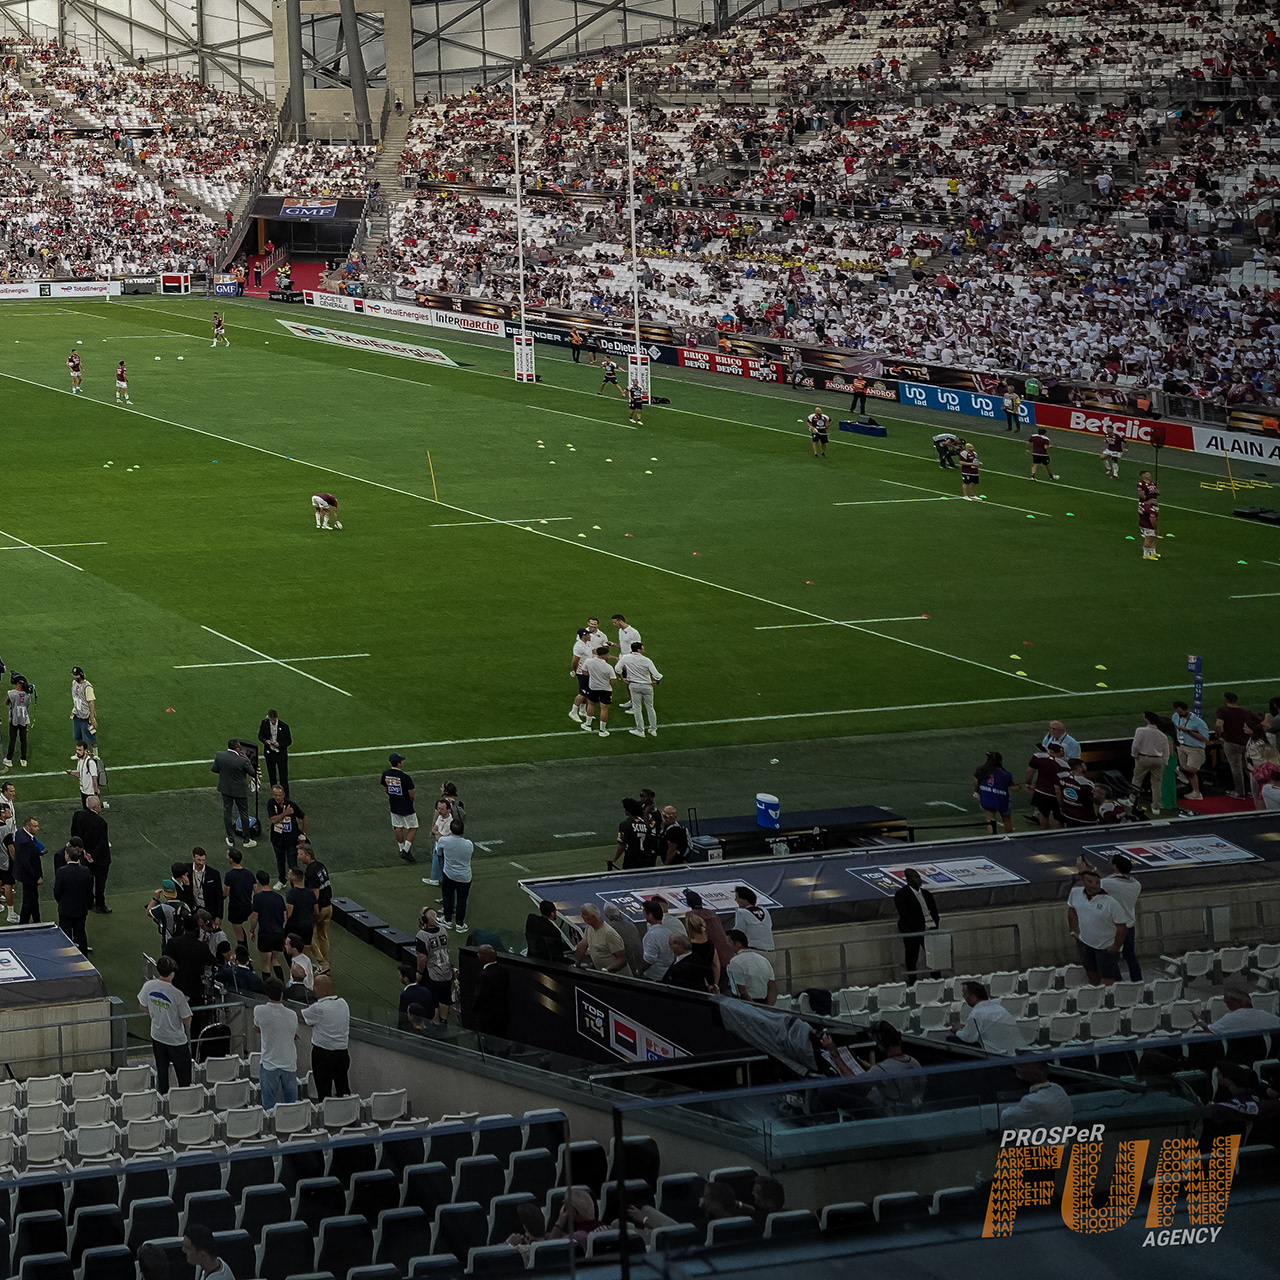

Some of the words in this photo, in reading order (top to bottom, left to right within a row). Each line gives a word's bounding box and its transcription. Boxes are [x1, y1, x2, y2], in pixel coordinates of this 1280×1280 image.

[285, 208, 332, 216] GMF
[216, 284, 236, 293] GMF
[383, 306, 430, 320] TotalEnergies
[435, 312, 499, 332] Intermarché
[326, 331, 447, 361] TotalEnergies
[601, 339, 613, 349] De
[684, 351, 709, 361] BRICO
[715, 355, 742, 366] BRICO
[684, 359, 711, 370] DEPÔT
[716, 364, 744, 376] DEPÔT
[826, 382, 854, 392] ANDROS
[866, 388, 896, 399] ANDROS
[946, 403, 960, 411] iad
[980, 409, 994, 417] iad
[1070, 412, 1154, 441] Betclic
[1206, 436, 1264, 458] ALAIN
[637, 833, 646, 851] 7
[582, 1001, 605, 1018] TOP
[585, 1017, 605, 1038] 14
